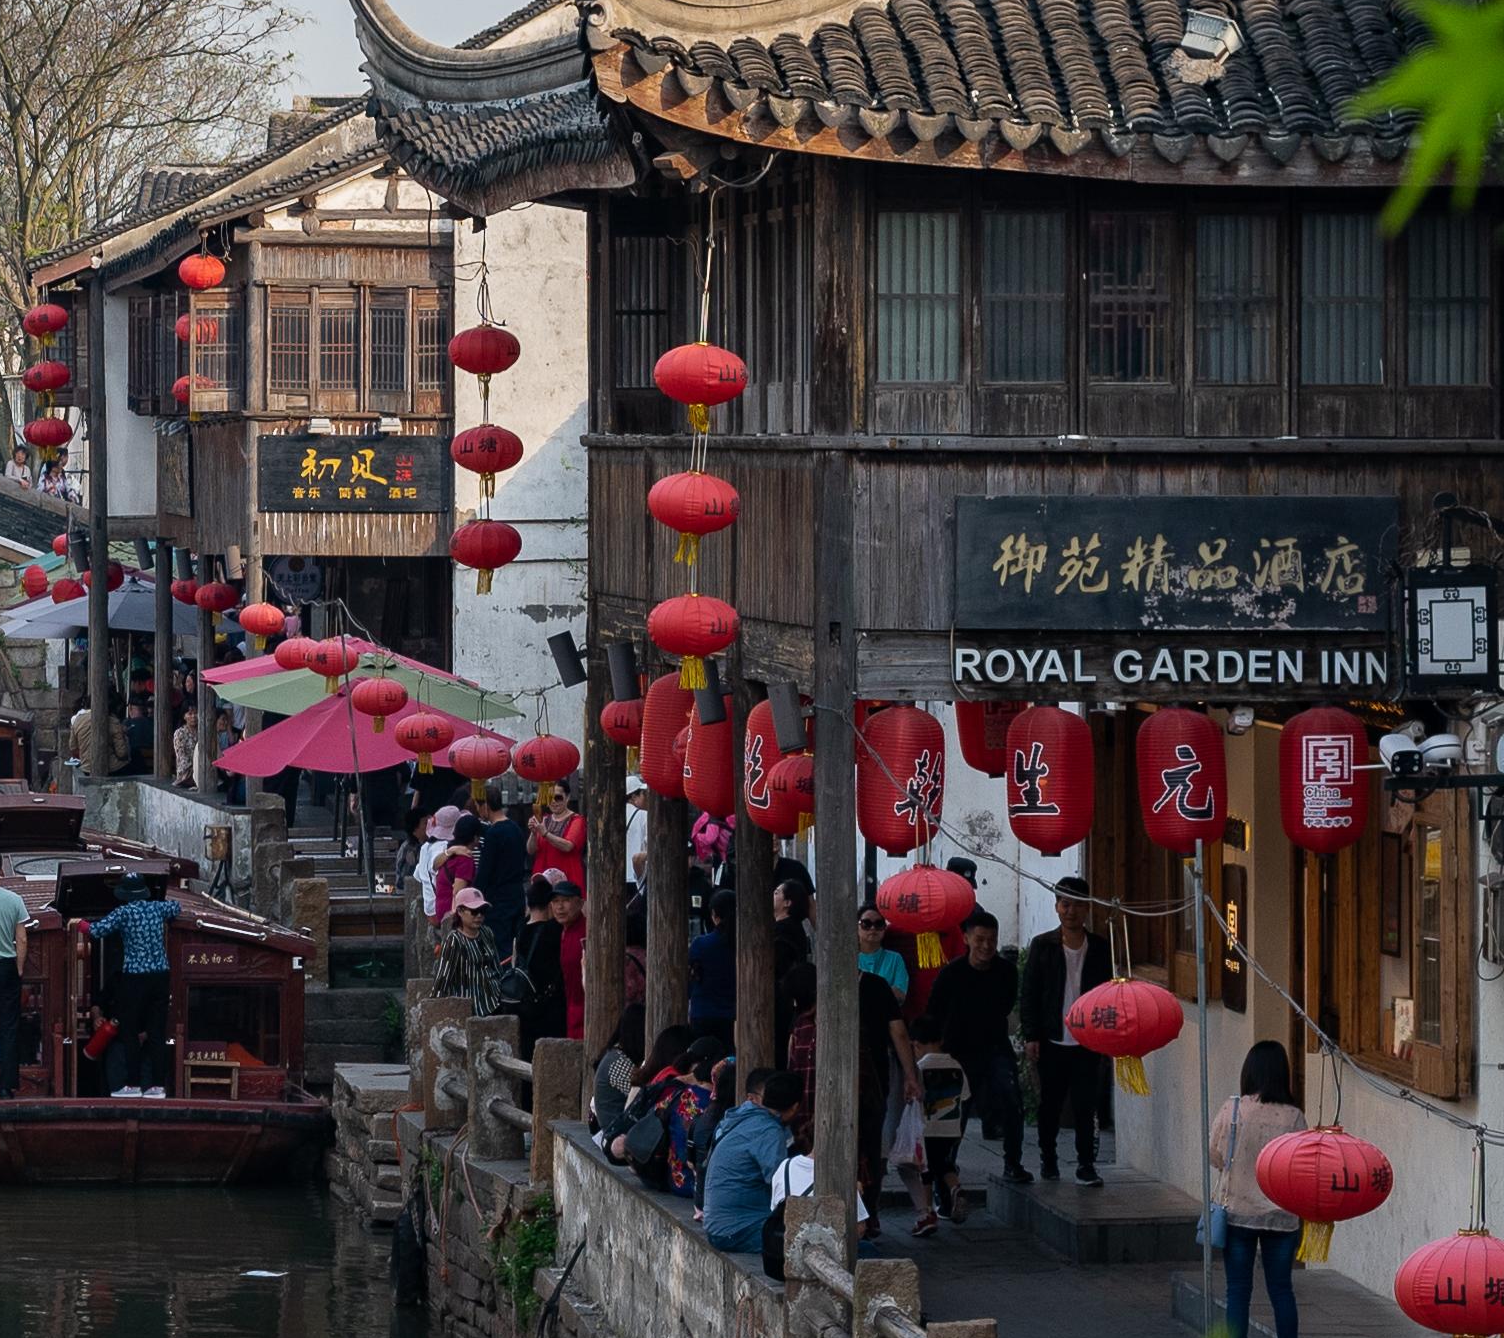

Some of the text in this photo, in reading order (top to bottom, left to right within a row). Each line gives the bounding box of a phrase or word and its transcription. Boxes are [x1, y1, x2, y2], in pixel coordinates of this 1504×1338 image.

[458, 437, 497, 455] 山塘
[300, 448, 388, 485] 初见
[292, 487, 321, 499] 音乐
[388, 487, 418, 499] 酒吧
[993, 532, 1367, 596] 御苑精品酒店
[955, 647, 1388, 685] ROYAL GARDEN INN
[1152, 744, 1214, 821] 元
[1303, 785, 1341, 798] China
[879, 892, 921, 913] 山塘
[1070, 1005, 1119, 1029] 山塘
[1331, 1165, 1391, 1193] 山塘
